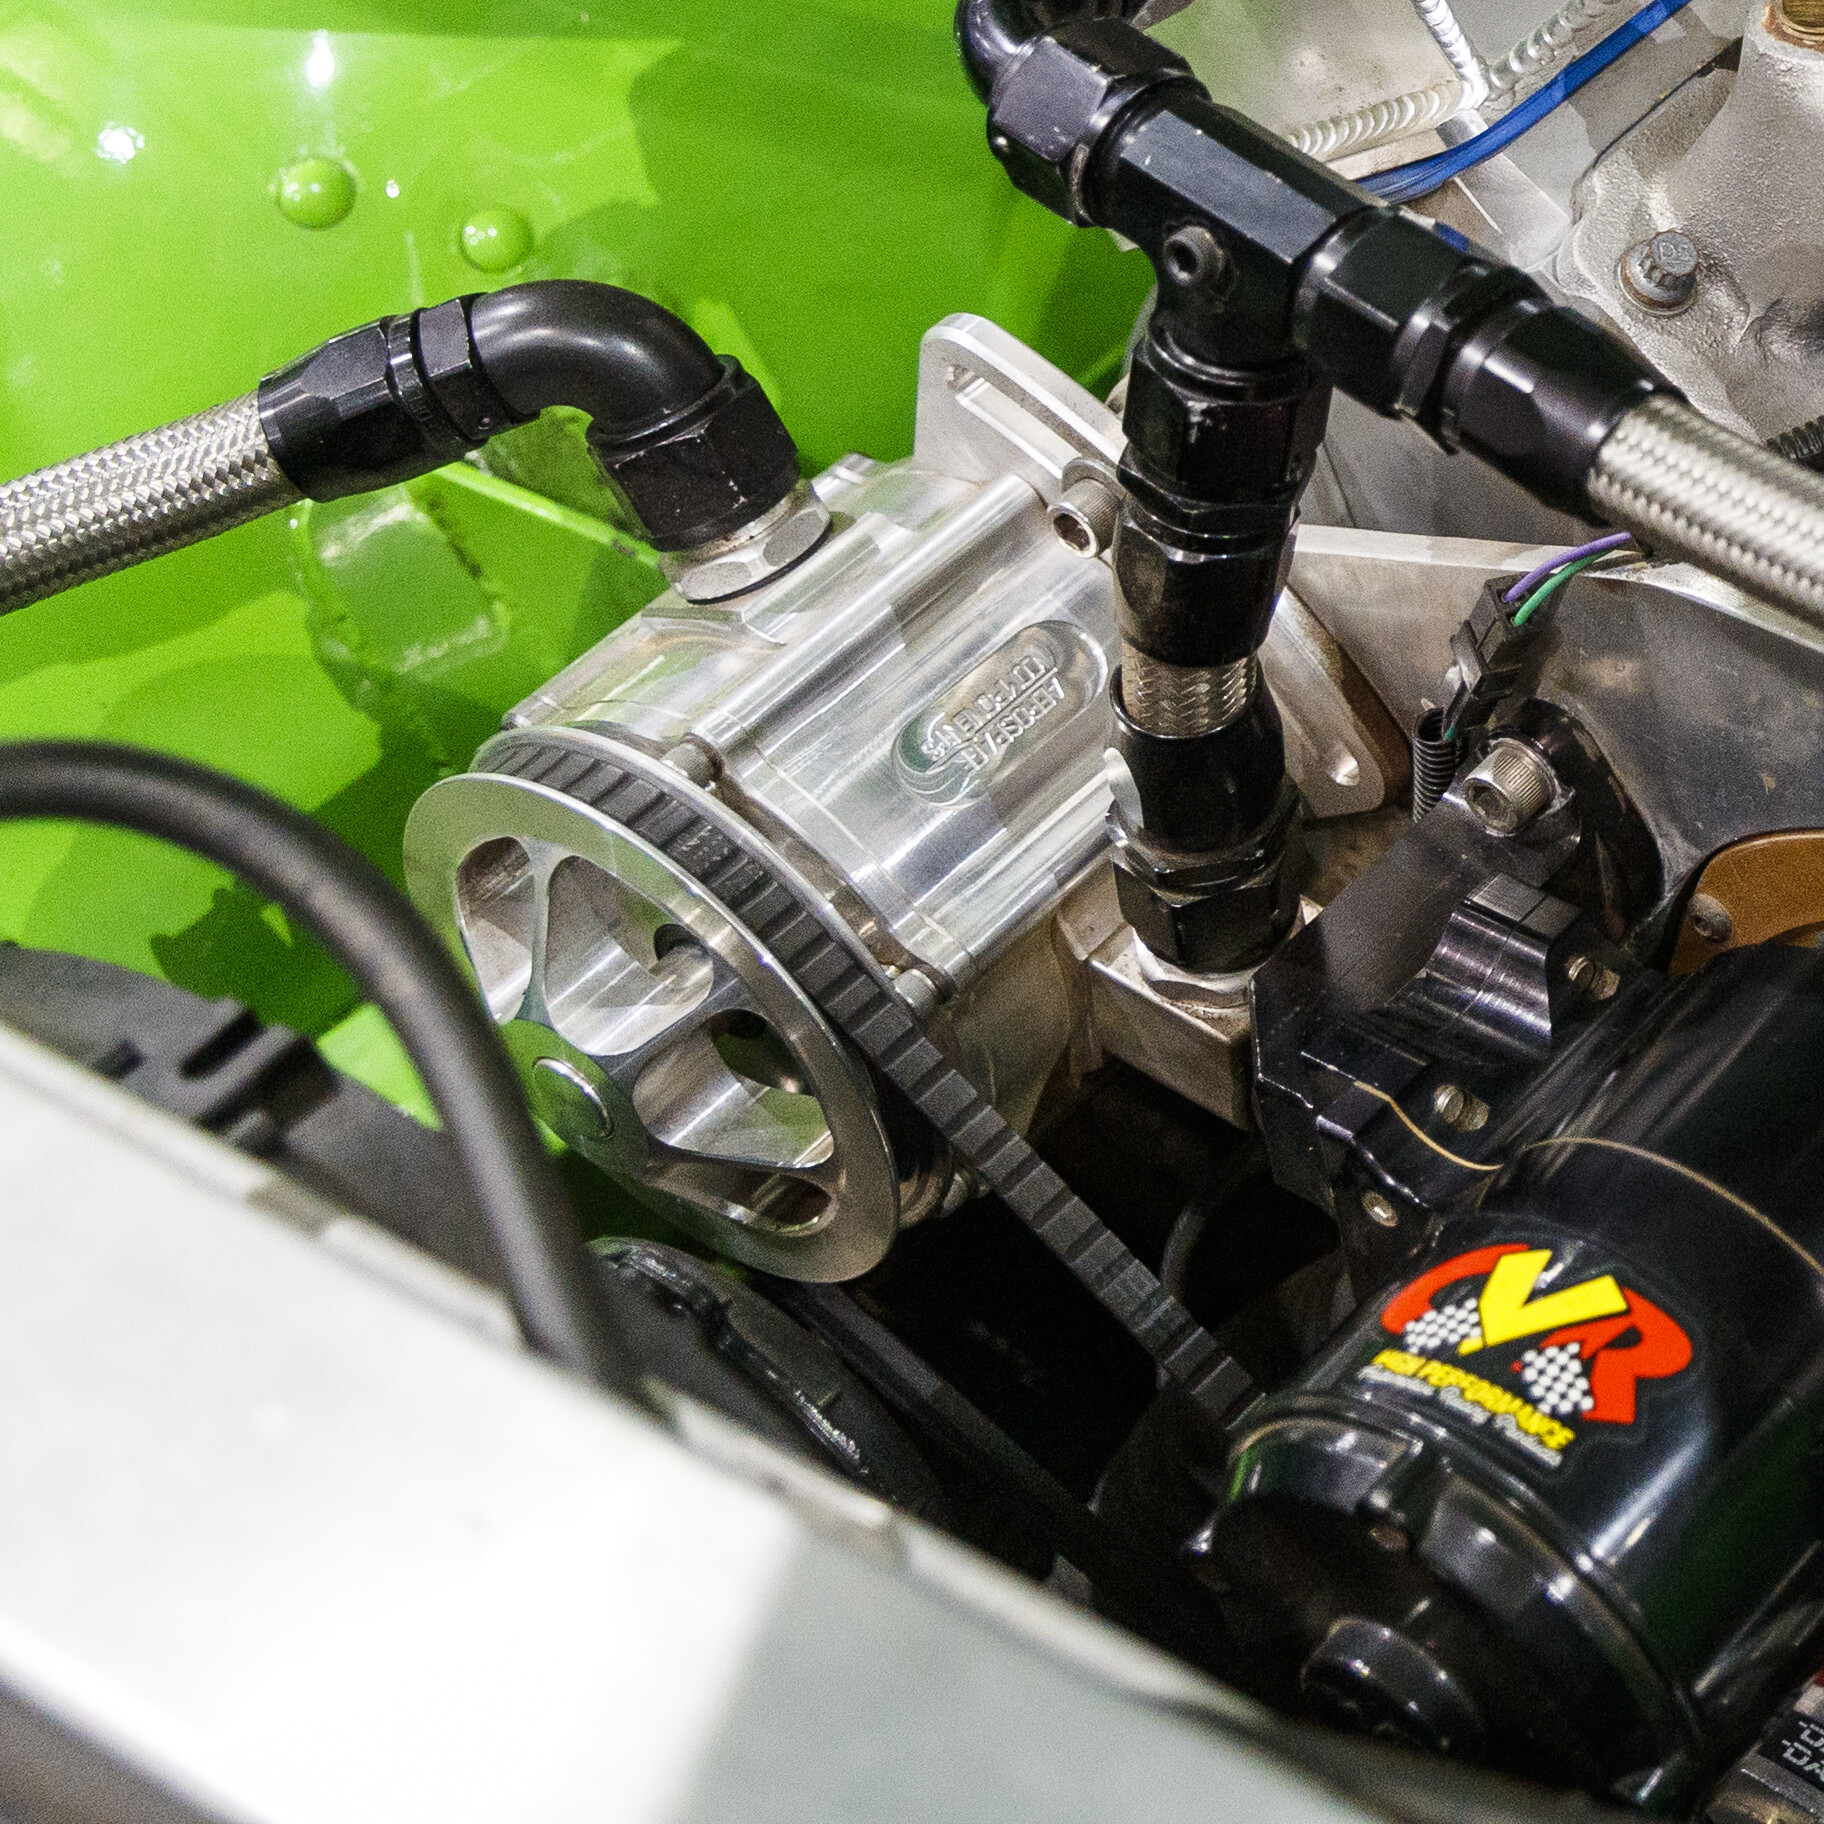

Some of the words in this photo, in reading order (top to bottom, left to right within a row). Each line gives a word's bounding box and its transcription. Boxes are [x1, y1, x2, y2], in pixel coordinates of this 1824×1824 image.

[960, 676, 1066, 772] AEROSPACE
[1380, 1242, 1693, 1425] CVR
[1414, 1359, 1575, 1450] PERFORMANCE
